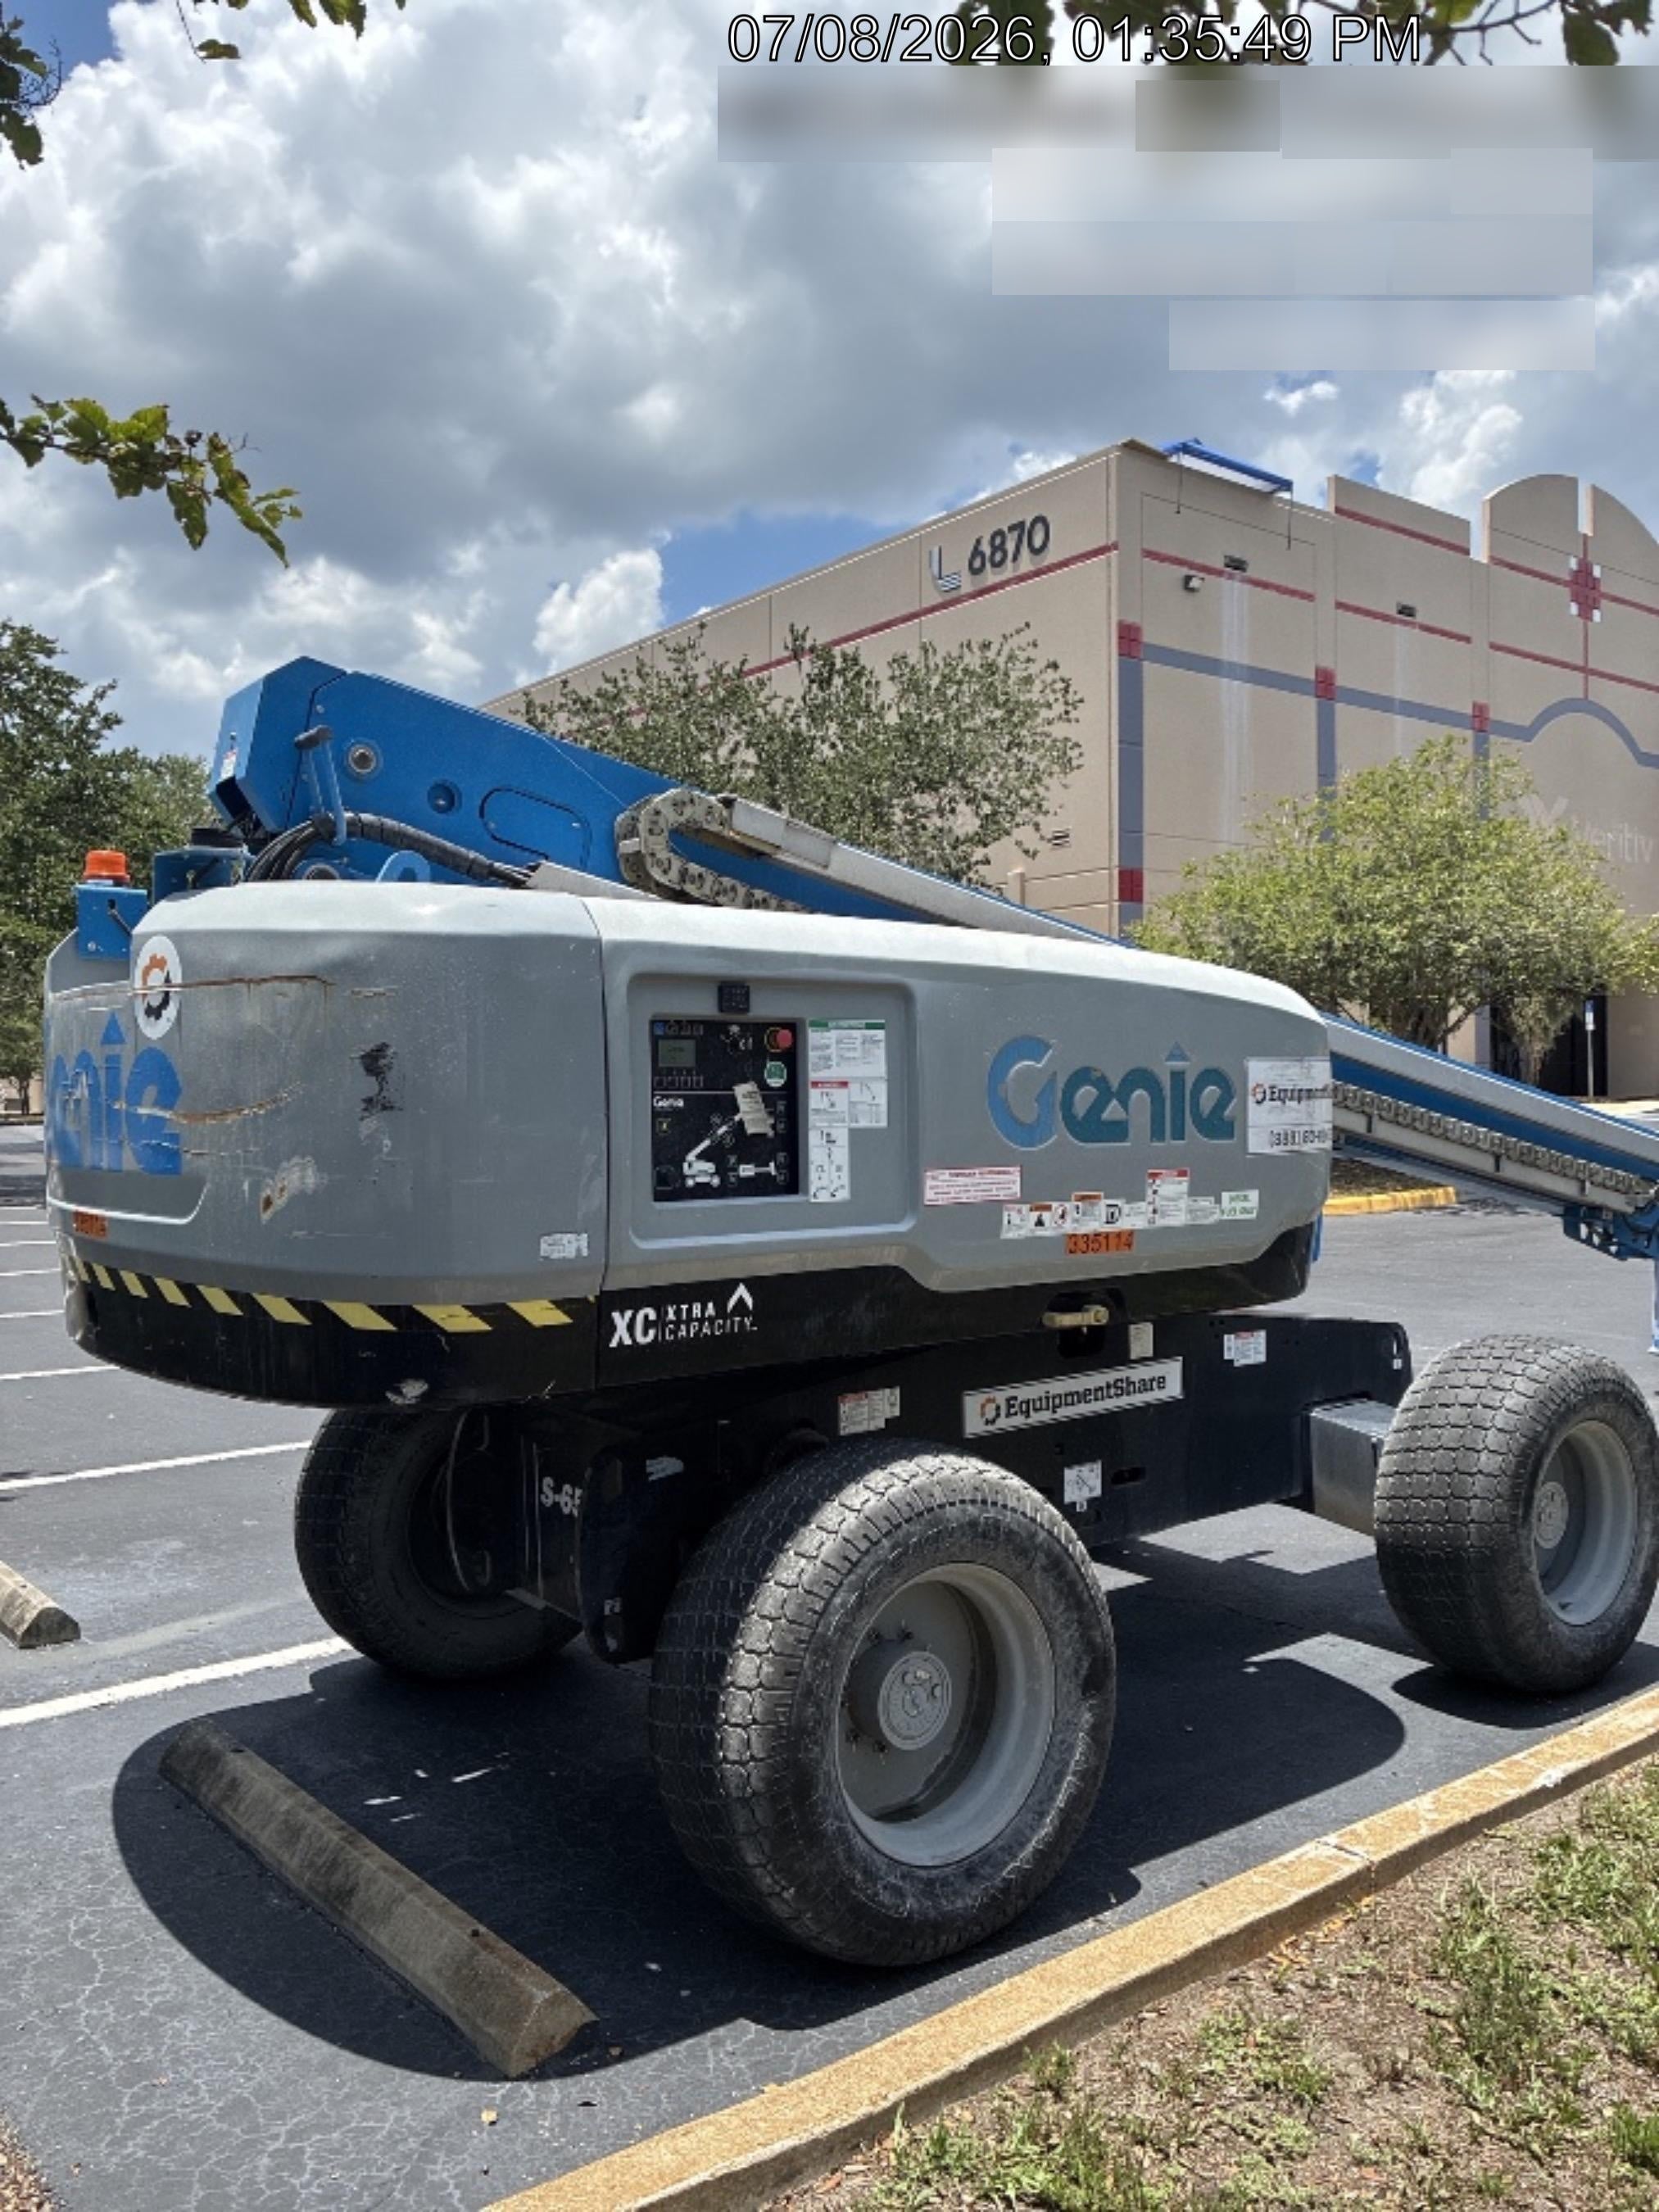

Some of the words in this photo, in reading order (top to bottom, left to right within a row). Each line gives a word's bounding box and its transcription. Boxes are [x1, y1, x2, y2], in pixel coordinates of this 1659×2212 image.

[968, 514, 1050, 575] 6870
[987, 1034, 1235, 1150] Genie
[609, 1307, 656, 1348] XC
[665, 1315, 753, 1341] CAPACITY
[666, 1301, 715, 1322] XTRA
[1004, 1376, 1167, 1419] EquipmentShare
